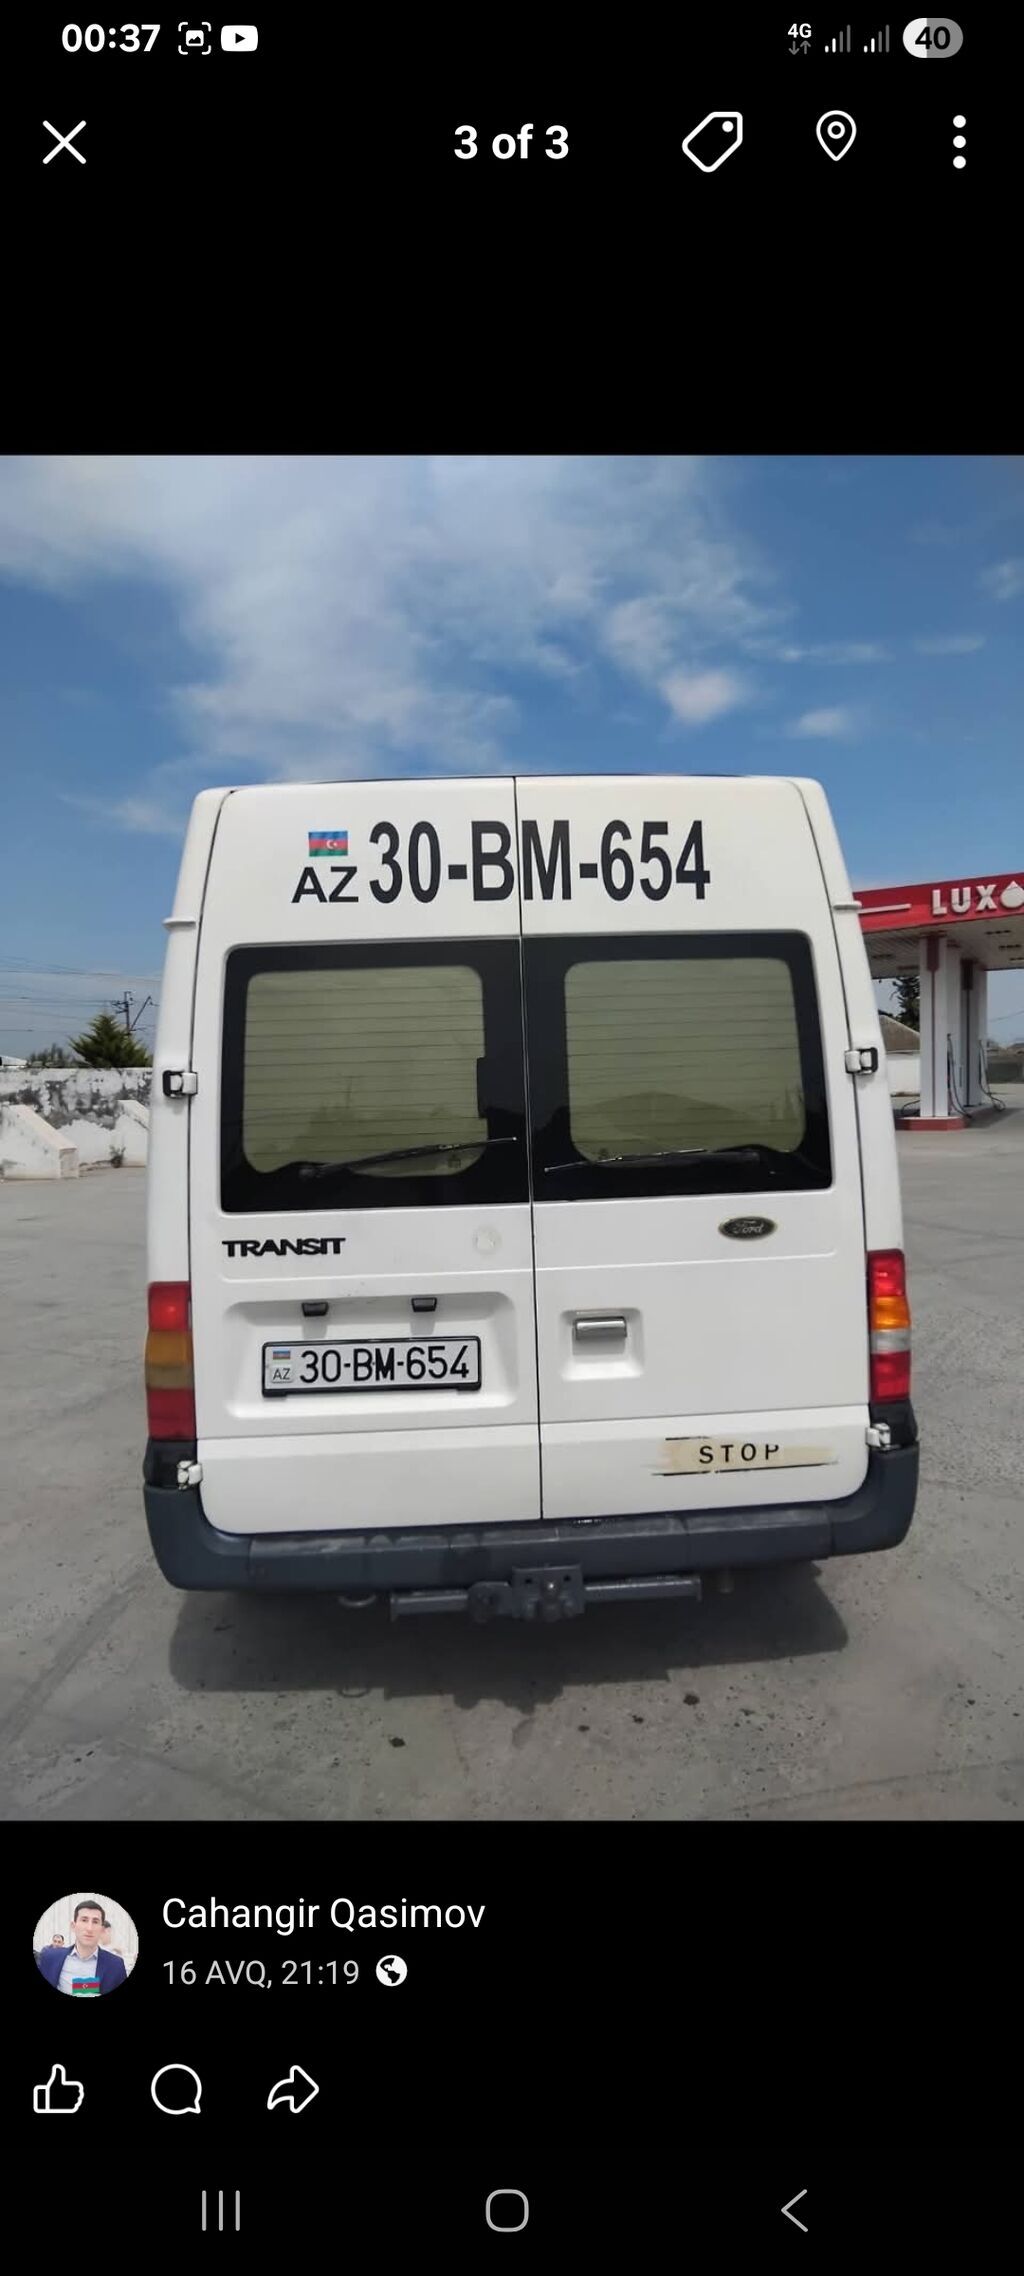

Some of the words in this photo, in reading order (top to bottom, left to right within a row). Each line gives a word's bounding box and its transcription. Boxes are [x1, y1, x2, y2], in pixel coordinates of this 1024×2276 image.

[292, 866, 359, 903] AZ
[369, 819, 711, 904] 30-BM-654
[222, 1238, 346, 1257] TRANSIT
[272, 1368, 291, 1381] AZ
[300, 1345, 470, 1383] 30-BM-654
[699, 1443, 780, 1464] STOP
